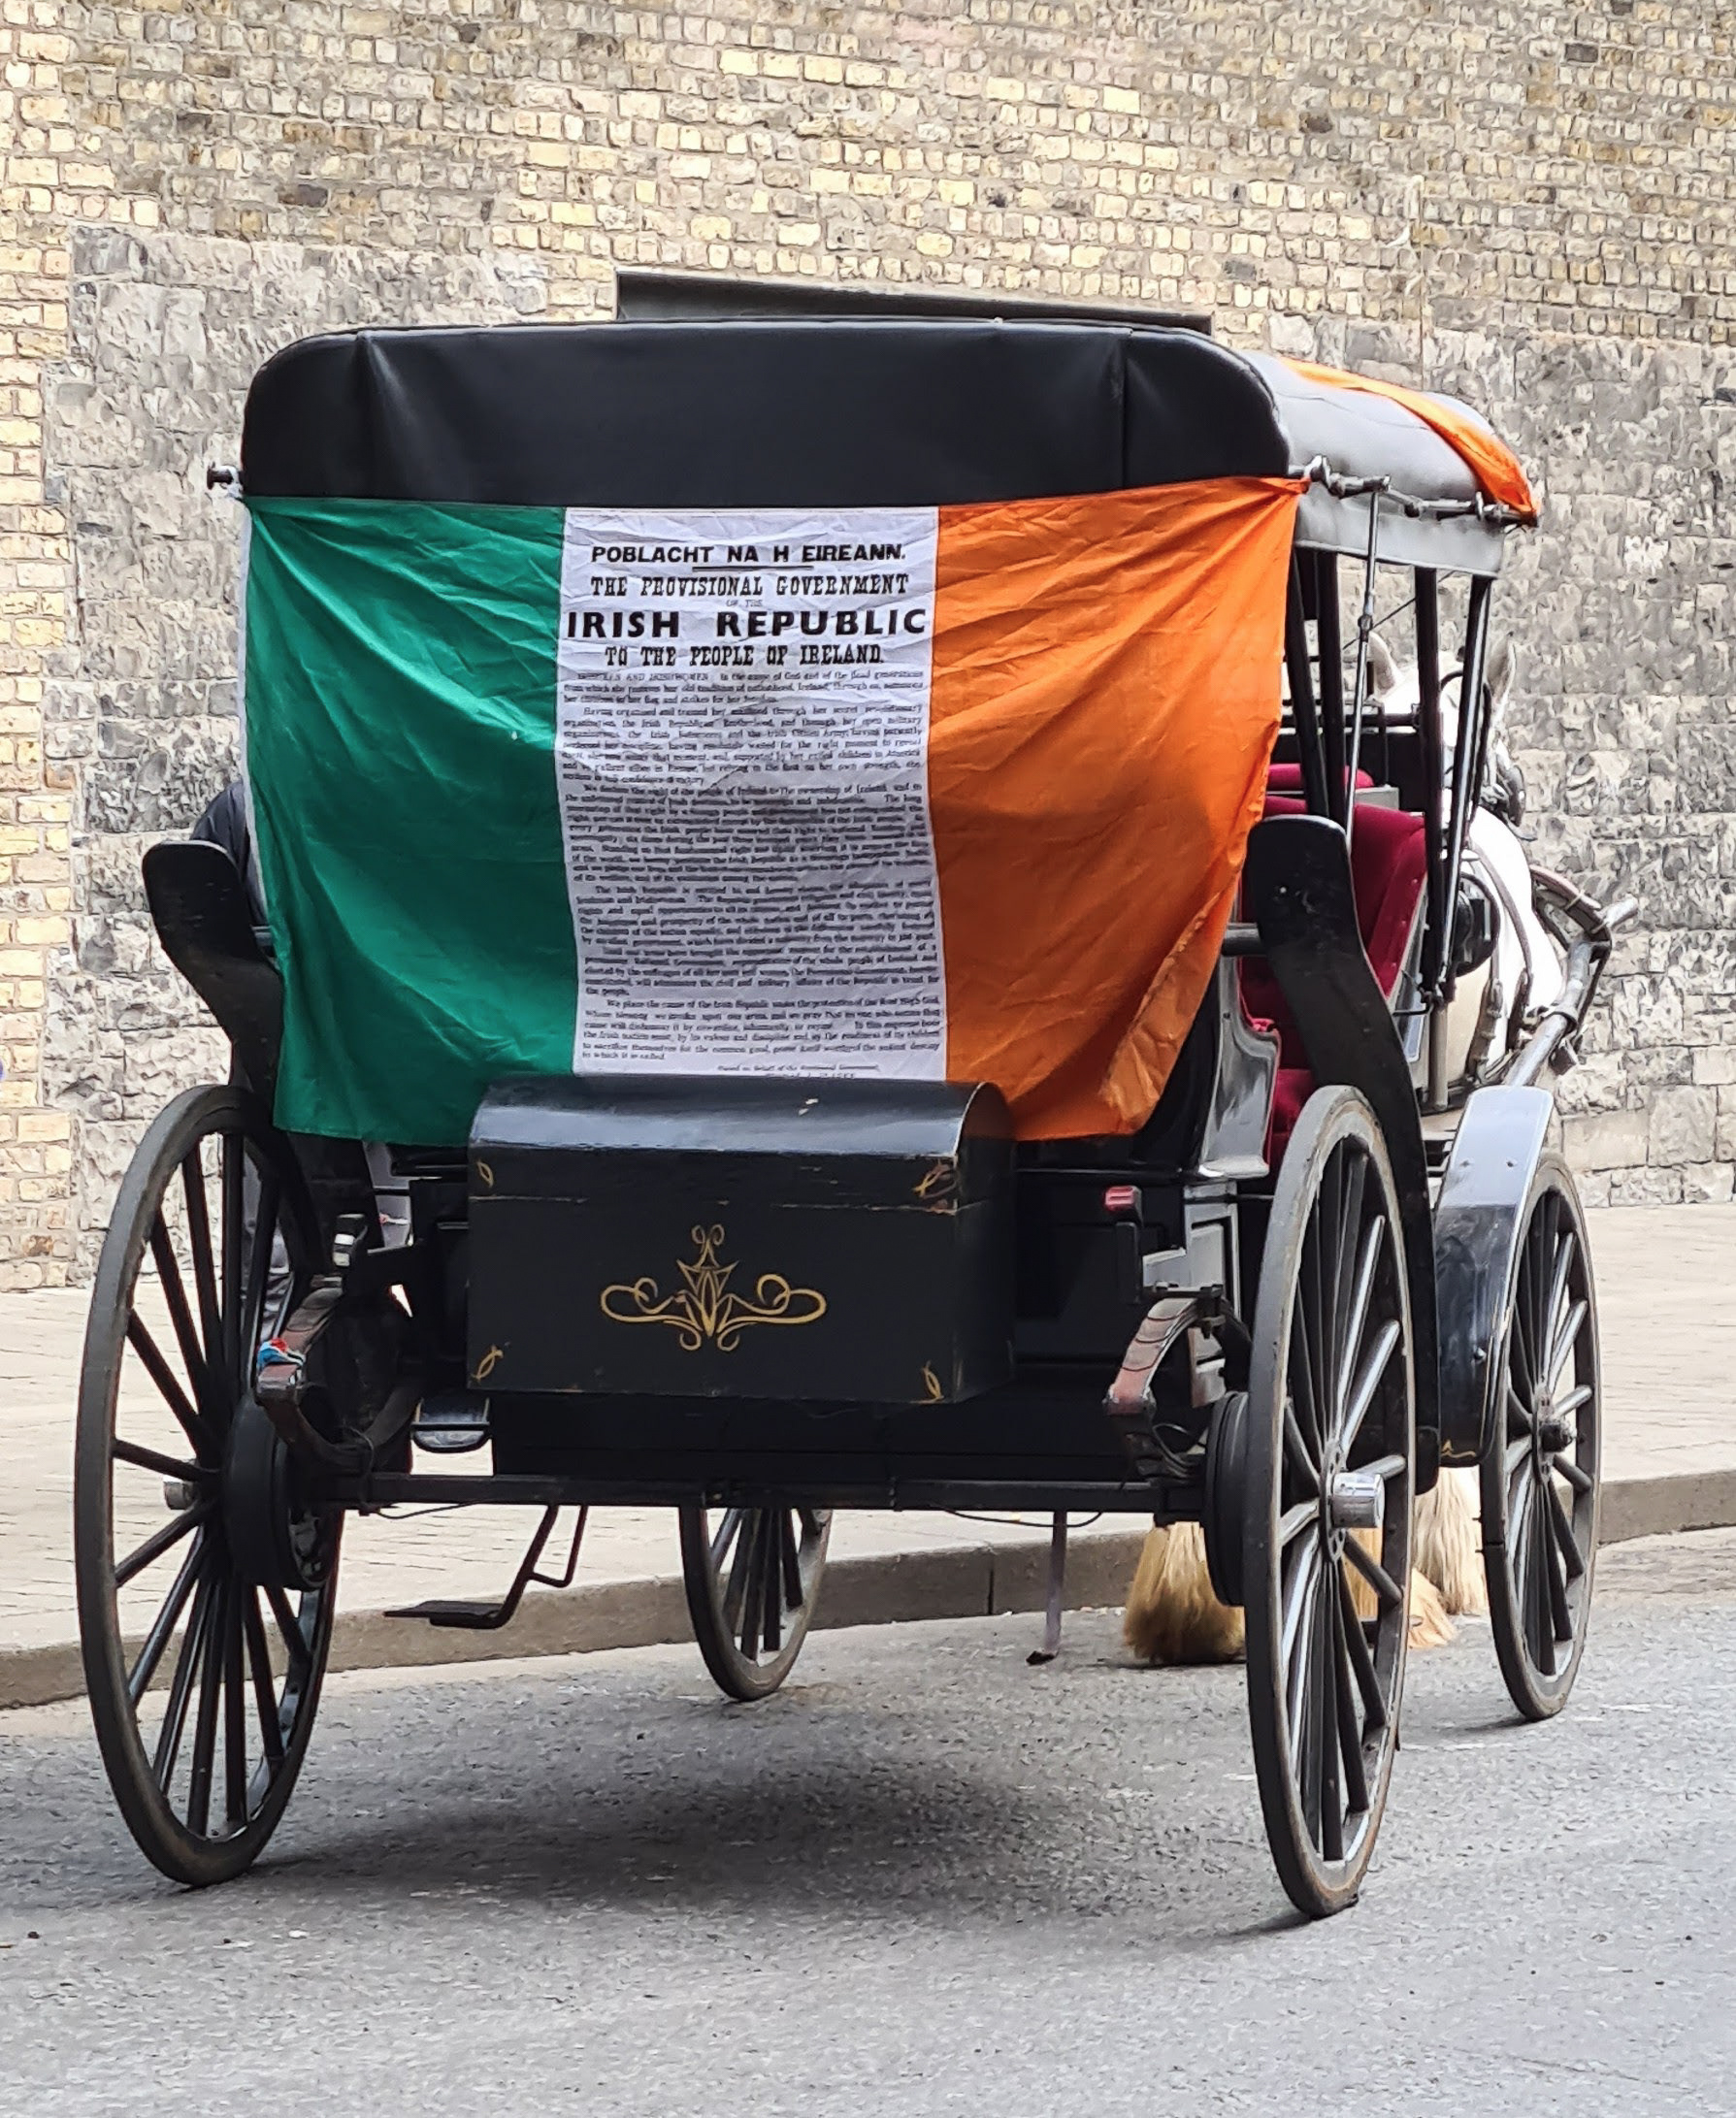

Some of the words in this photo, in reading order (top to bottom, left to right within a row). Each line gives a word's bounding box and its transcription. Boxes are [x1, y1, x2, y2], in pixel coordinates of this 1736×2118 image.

[592, 546, 714, 563] POBLACHT
[727, 545, 757, 562] NA
[773, 544, 789, 562] H
[802, 543, 905, 562] EIREANN.
[591, 576, 627, 597] THE
[640, 576, 763, 597] PROVISIONAL
[776, 573, 909, 595] GOVERNMENT
[567, 612, 679, 638] IRISH
[717, 609, 926, 636] REPUBLIC
[605, 647, 627, 666] TO
[640, 646, 676, 666] THE
[690, 646, 753, 667] PEOPLE
[768, 646, 788, 666] OF
[800, 645, 884, 665] IRELAND.
